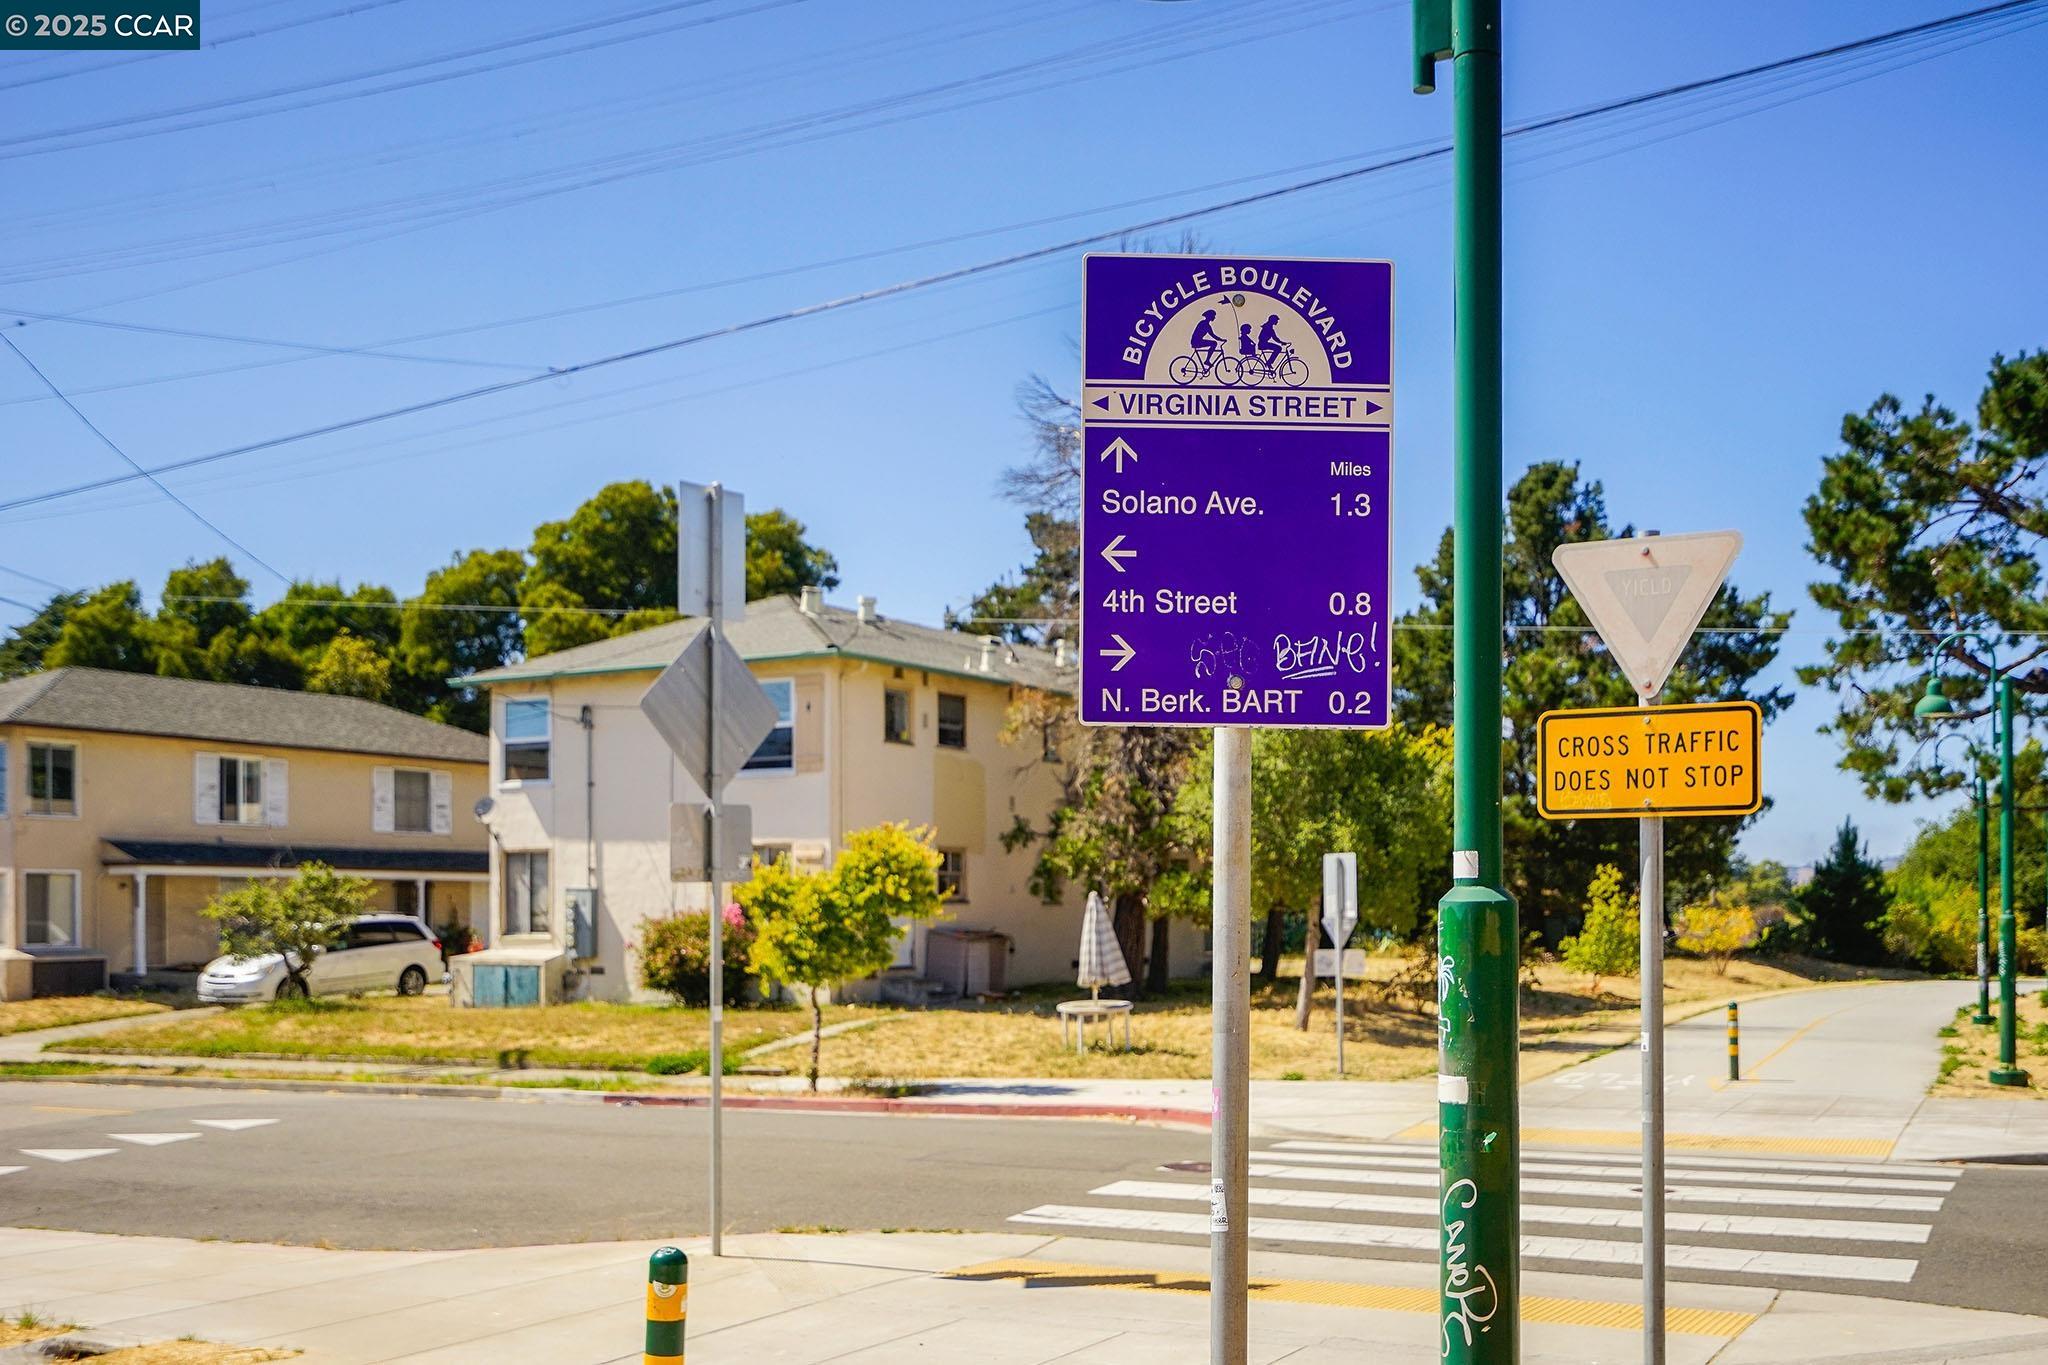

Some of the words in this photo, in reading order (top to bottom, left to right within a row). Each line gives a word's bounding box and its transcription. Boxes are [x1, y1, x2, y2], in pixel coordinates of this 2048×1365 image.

[1122, 271, 1210, 365] BICYCLE
[1220, 266, 1352, 369] BOULEVARD
[1118, 393, 1241, 417] VIRGINIA
[1248, 396, 1357, 418] STREET
[1330, 461, 1372, 477] Miles
[1101, 489, 1197, 515] Solano
[1204, 491, 1265, 515] Ave.
[1330, 493, 1372, 517] 1.3
[1621, 577, 1672, 596] YIELD
[1102, 589, 1145, 613] 4th
[1155, 589, 1238, 614] Street
[1328, 592, 1372, 616] 0.8
[1101, 688, 1130, 712] N.
[1141, 688, 1211, 713] Berk.
[1222, 689, 1303, 714] BART
[1328, 691, 1372, 715] 0.2
[1558, 735, 1630, 758] CROSS
[1644, 729, 1740, 754] TRAFFIC
[1554, 769, 1611, 791] DOES
[1626, 767, 1669, 790] NOT
[1685, 765, 1743, 788] STOP
